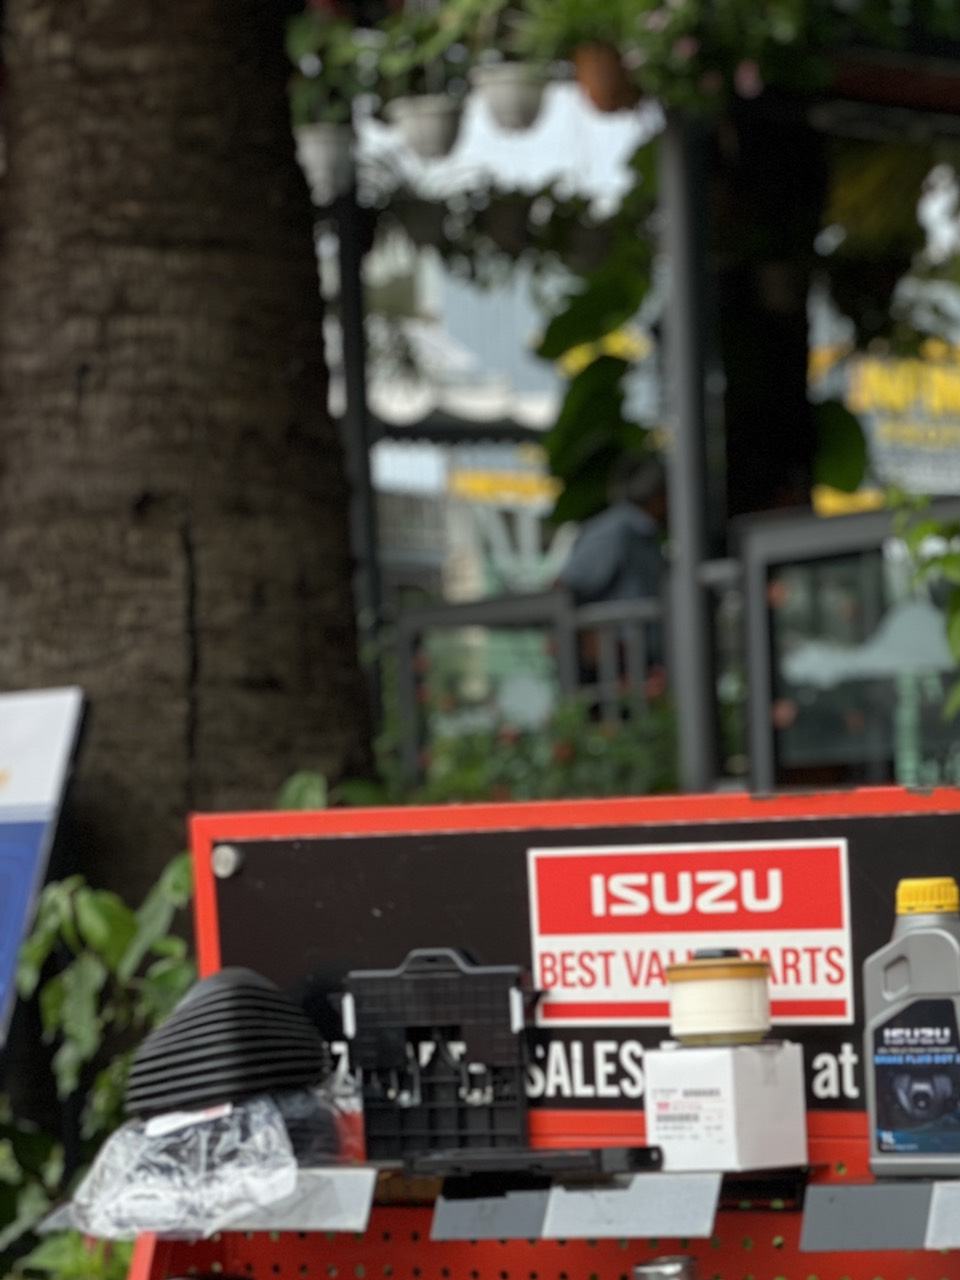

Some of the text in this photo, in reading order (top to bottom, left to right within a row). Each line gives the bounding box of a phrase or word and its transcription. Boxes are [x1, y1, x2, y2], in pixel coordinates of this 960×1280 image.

[590, 868, 783, 917] ISUZU
[539, 950, 615, 989] BEST
[883, 1027, 951, 1045] ISUZU
[812, 1041, 859, 1098] at
